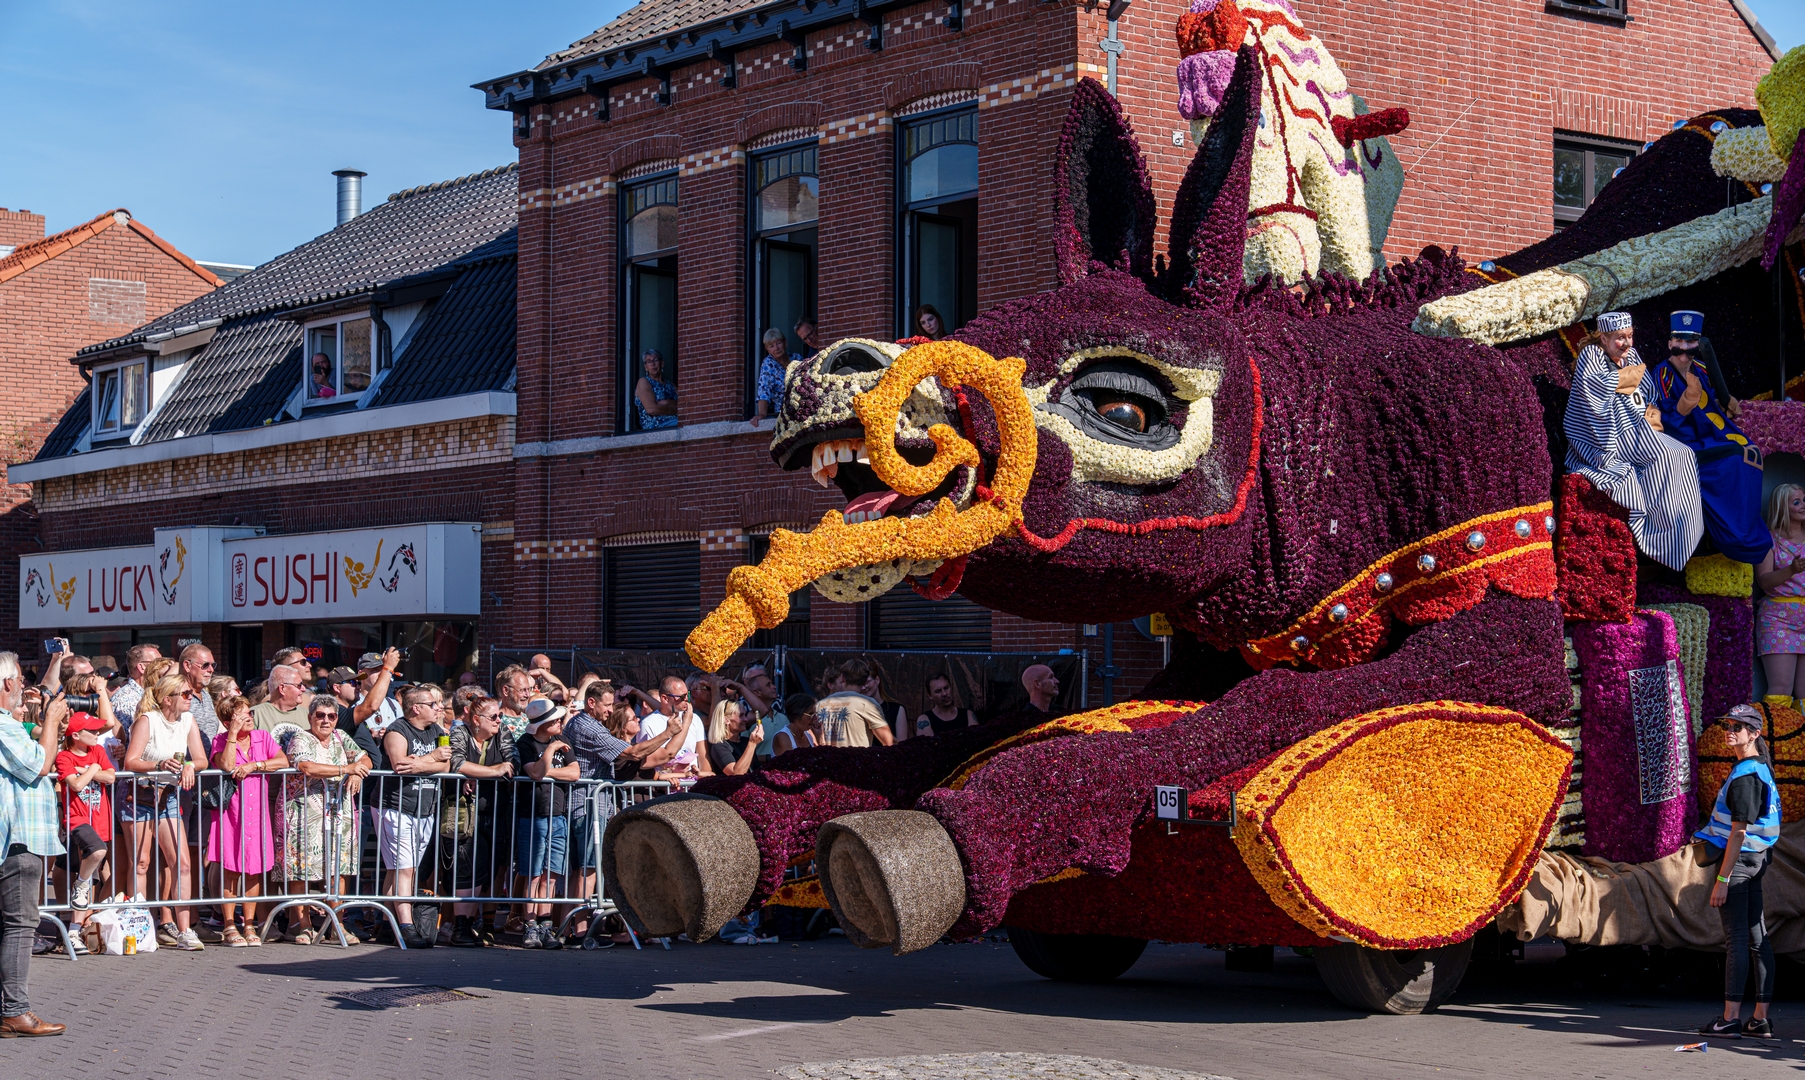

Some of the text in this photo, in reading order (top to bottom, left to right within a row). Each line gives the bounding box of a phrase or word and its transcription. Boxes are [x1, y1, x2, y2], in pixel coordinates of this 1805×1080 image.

[253, 551, 338, 607] SUSHI
[302, 647, 323, 658] OPEN
[1160, 790, 1177, 807] 05
